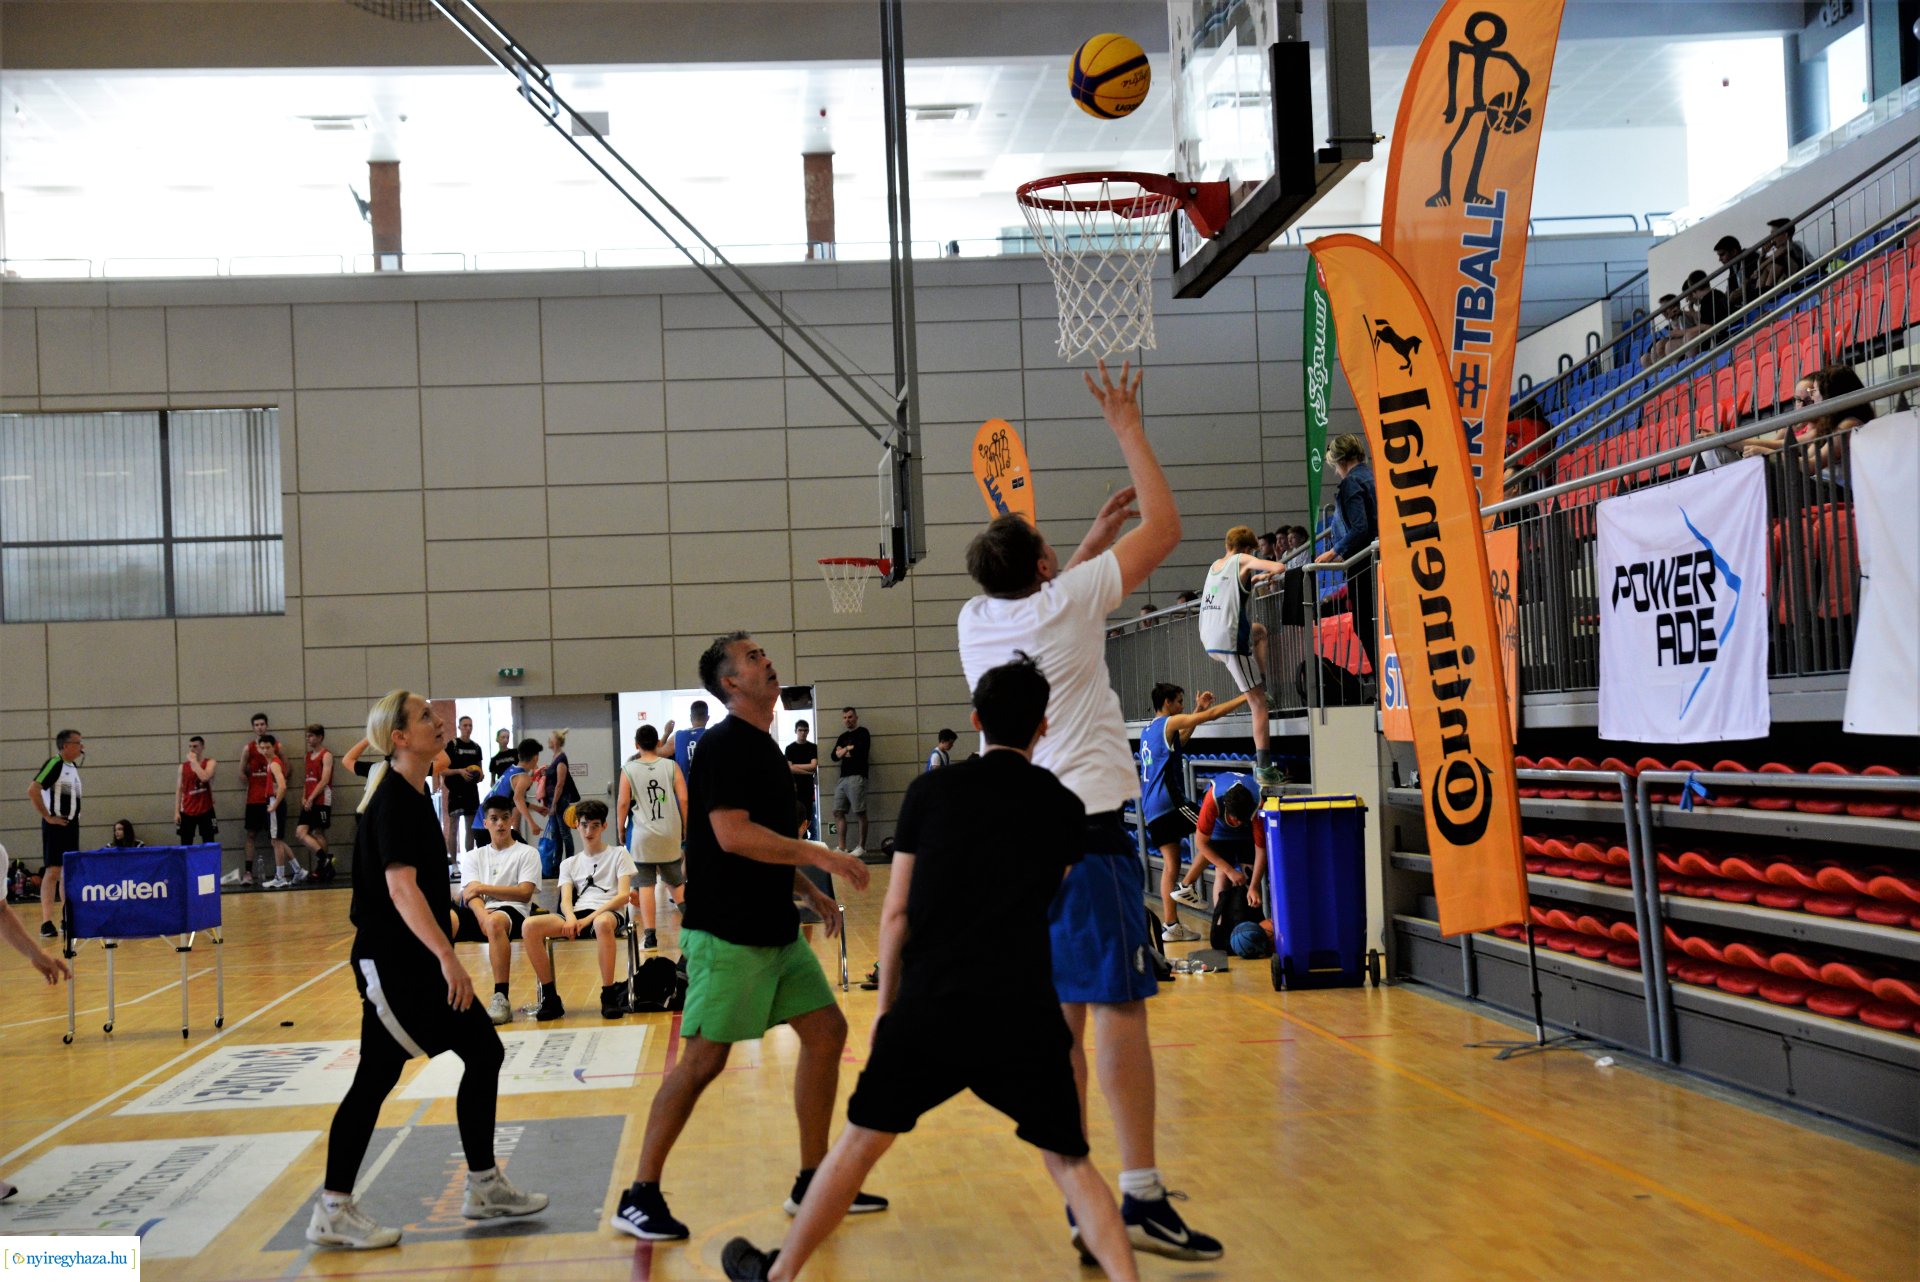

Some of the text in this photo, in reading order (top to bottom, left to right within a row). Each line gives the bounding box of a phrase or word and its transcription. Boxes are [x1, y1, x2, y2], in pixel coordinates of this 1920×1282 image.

[1612, 549, 1717, 613] POWER
[1378, 387, 1494, 846] Continental
[1656, 607, 1719, 667] ADE
[82, 879, 168, 902] molten
